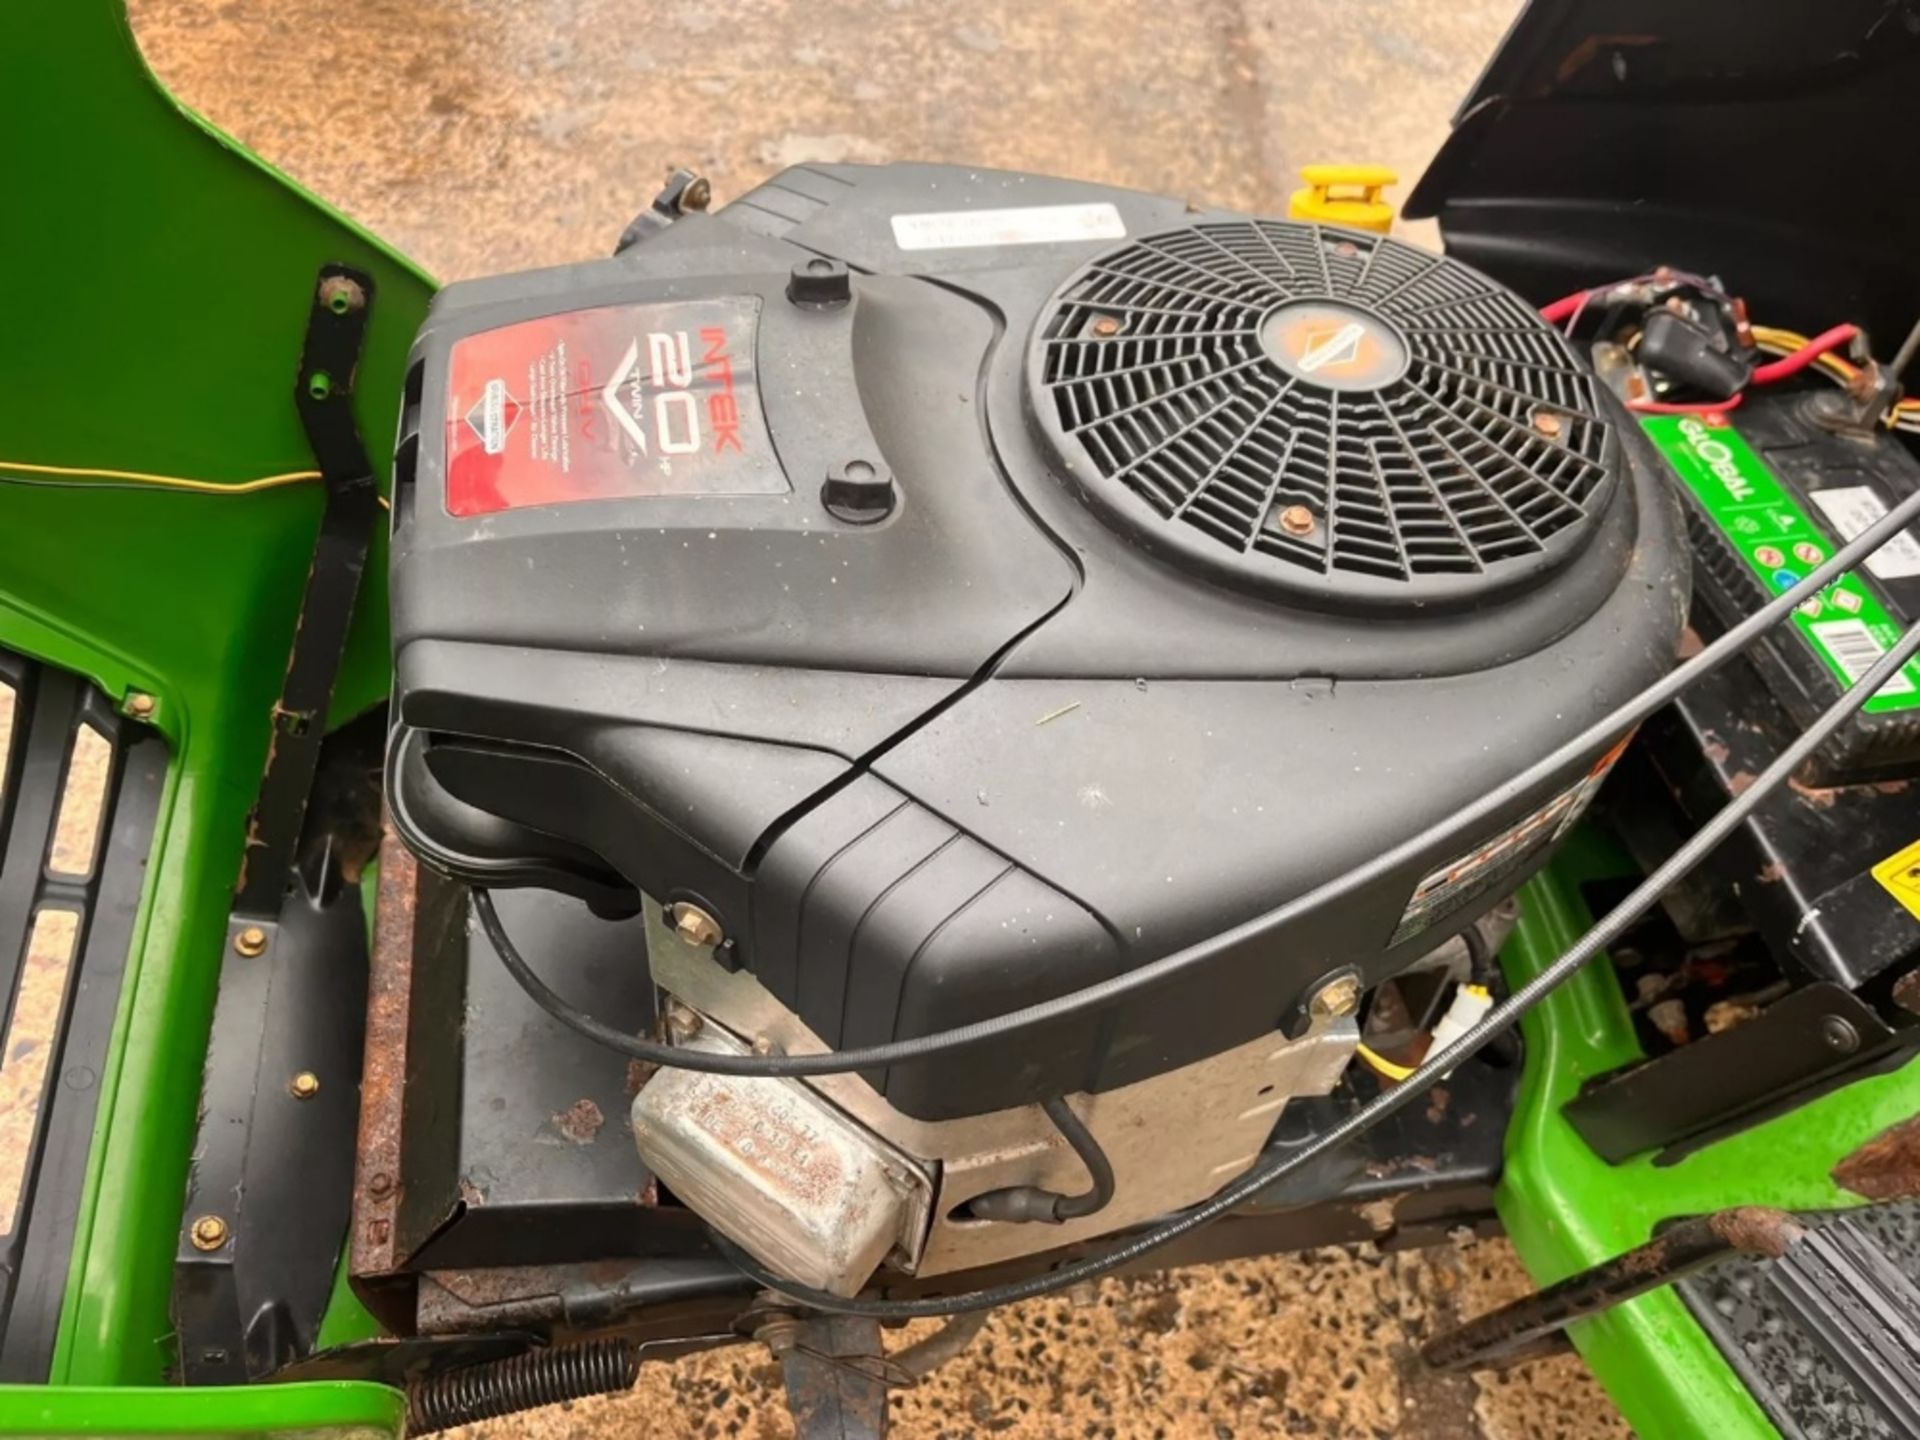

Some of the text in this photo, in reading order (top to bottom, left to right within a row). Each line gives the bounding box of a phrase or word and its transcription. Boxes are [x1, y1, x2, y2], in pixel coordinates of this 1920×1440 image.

[630, 367, 645, 420] TWIN
[647, 330, 702, 476] 20 HP
[700, 327, 744, 454] INTEK
[1677, 417, 1756, 502] GLOBAL
